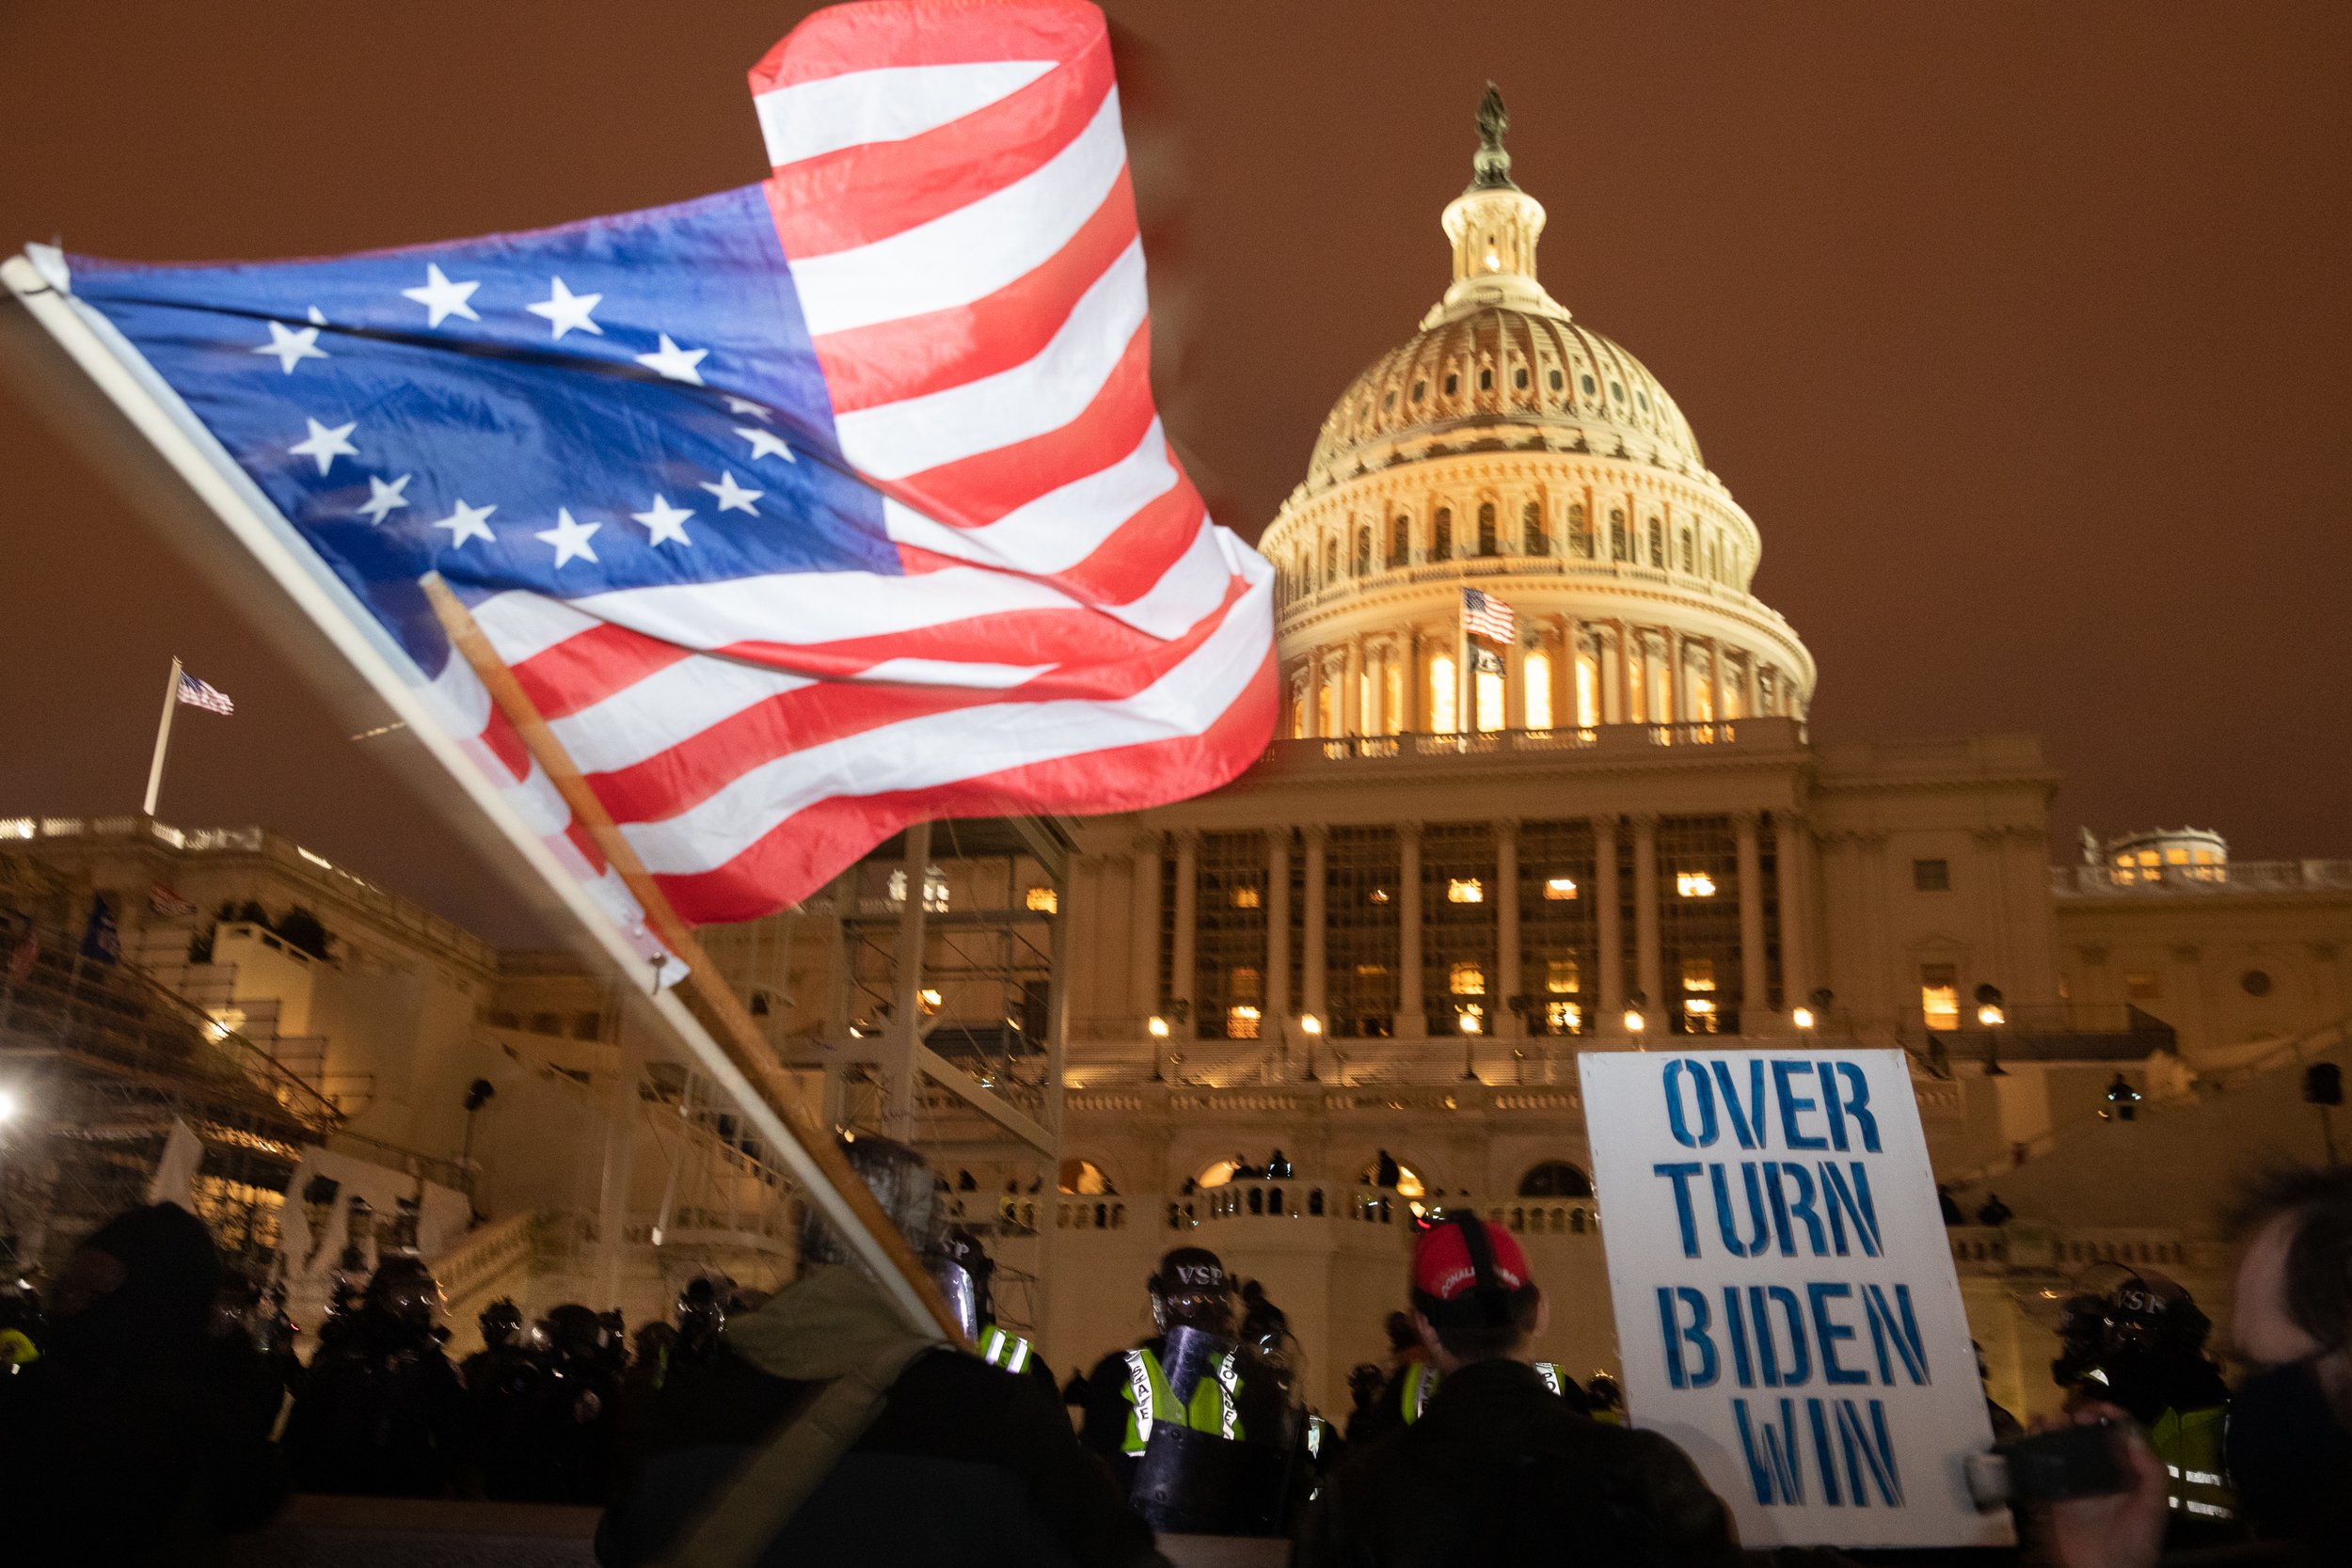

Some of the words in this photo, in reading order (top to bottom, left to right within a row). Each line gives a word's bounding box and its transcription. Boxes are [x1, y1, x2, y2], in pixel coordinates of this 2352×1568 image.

[1662, 1057, 1883, 1153] OVER
[1653, 1160, 1884, 1259] TURN
[1175, 1264, 1223, 1286] VSP
[1656, 1281, 1931, 1389] BIDEN
[1732, 1398, 1906, 1508] WIN
